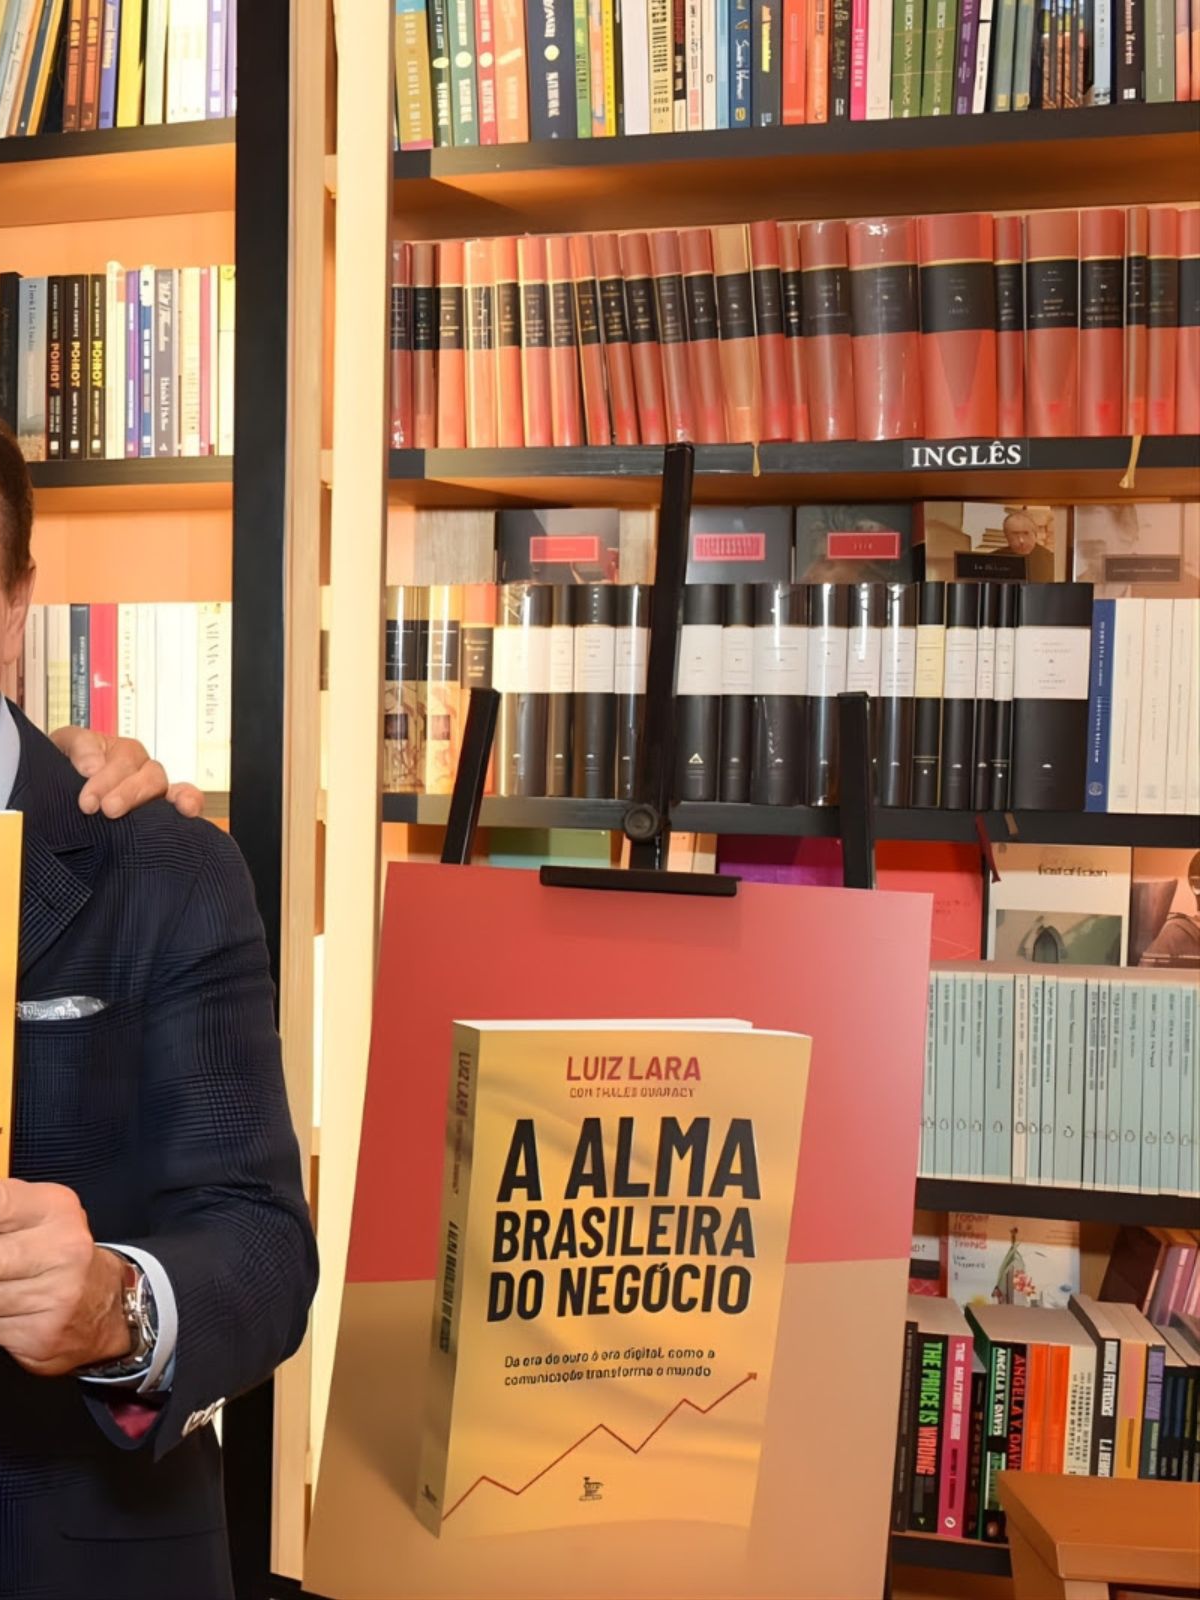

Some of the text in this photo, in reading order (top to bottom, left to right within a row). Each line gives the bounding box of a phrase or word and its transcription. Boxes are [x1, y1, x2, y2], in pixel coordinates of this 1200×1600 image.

[50, 342, 60, 389] POIROT
[70, 341, 81, 388] POIROT
[92, 340, 103, 388] POIROT
[910, 441, 1022, 467] INGLÊS
[566, 1056, 701, 1081] LUIZ LARA
[497, 1119, 543, 1202] A
[565, 1115, 762, 1202] ALMA
[491, 1204, 757, 1264] BRASILEIRA
[487, 1262, 752, 1323] DO NEGÓCIO
[954, 1342, 966, 1362] THE
[995, 1348, 1006, 1391] ANGELA
[1010, 1353, 1026, 1416] ANGELA
[916, 1342, 942, 1476] THE PRICE IS WRONG
[993, 1404, 1004, 1436] DAVIS
